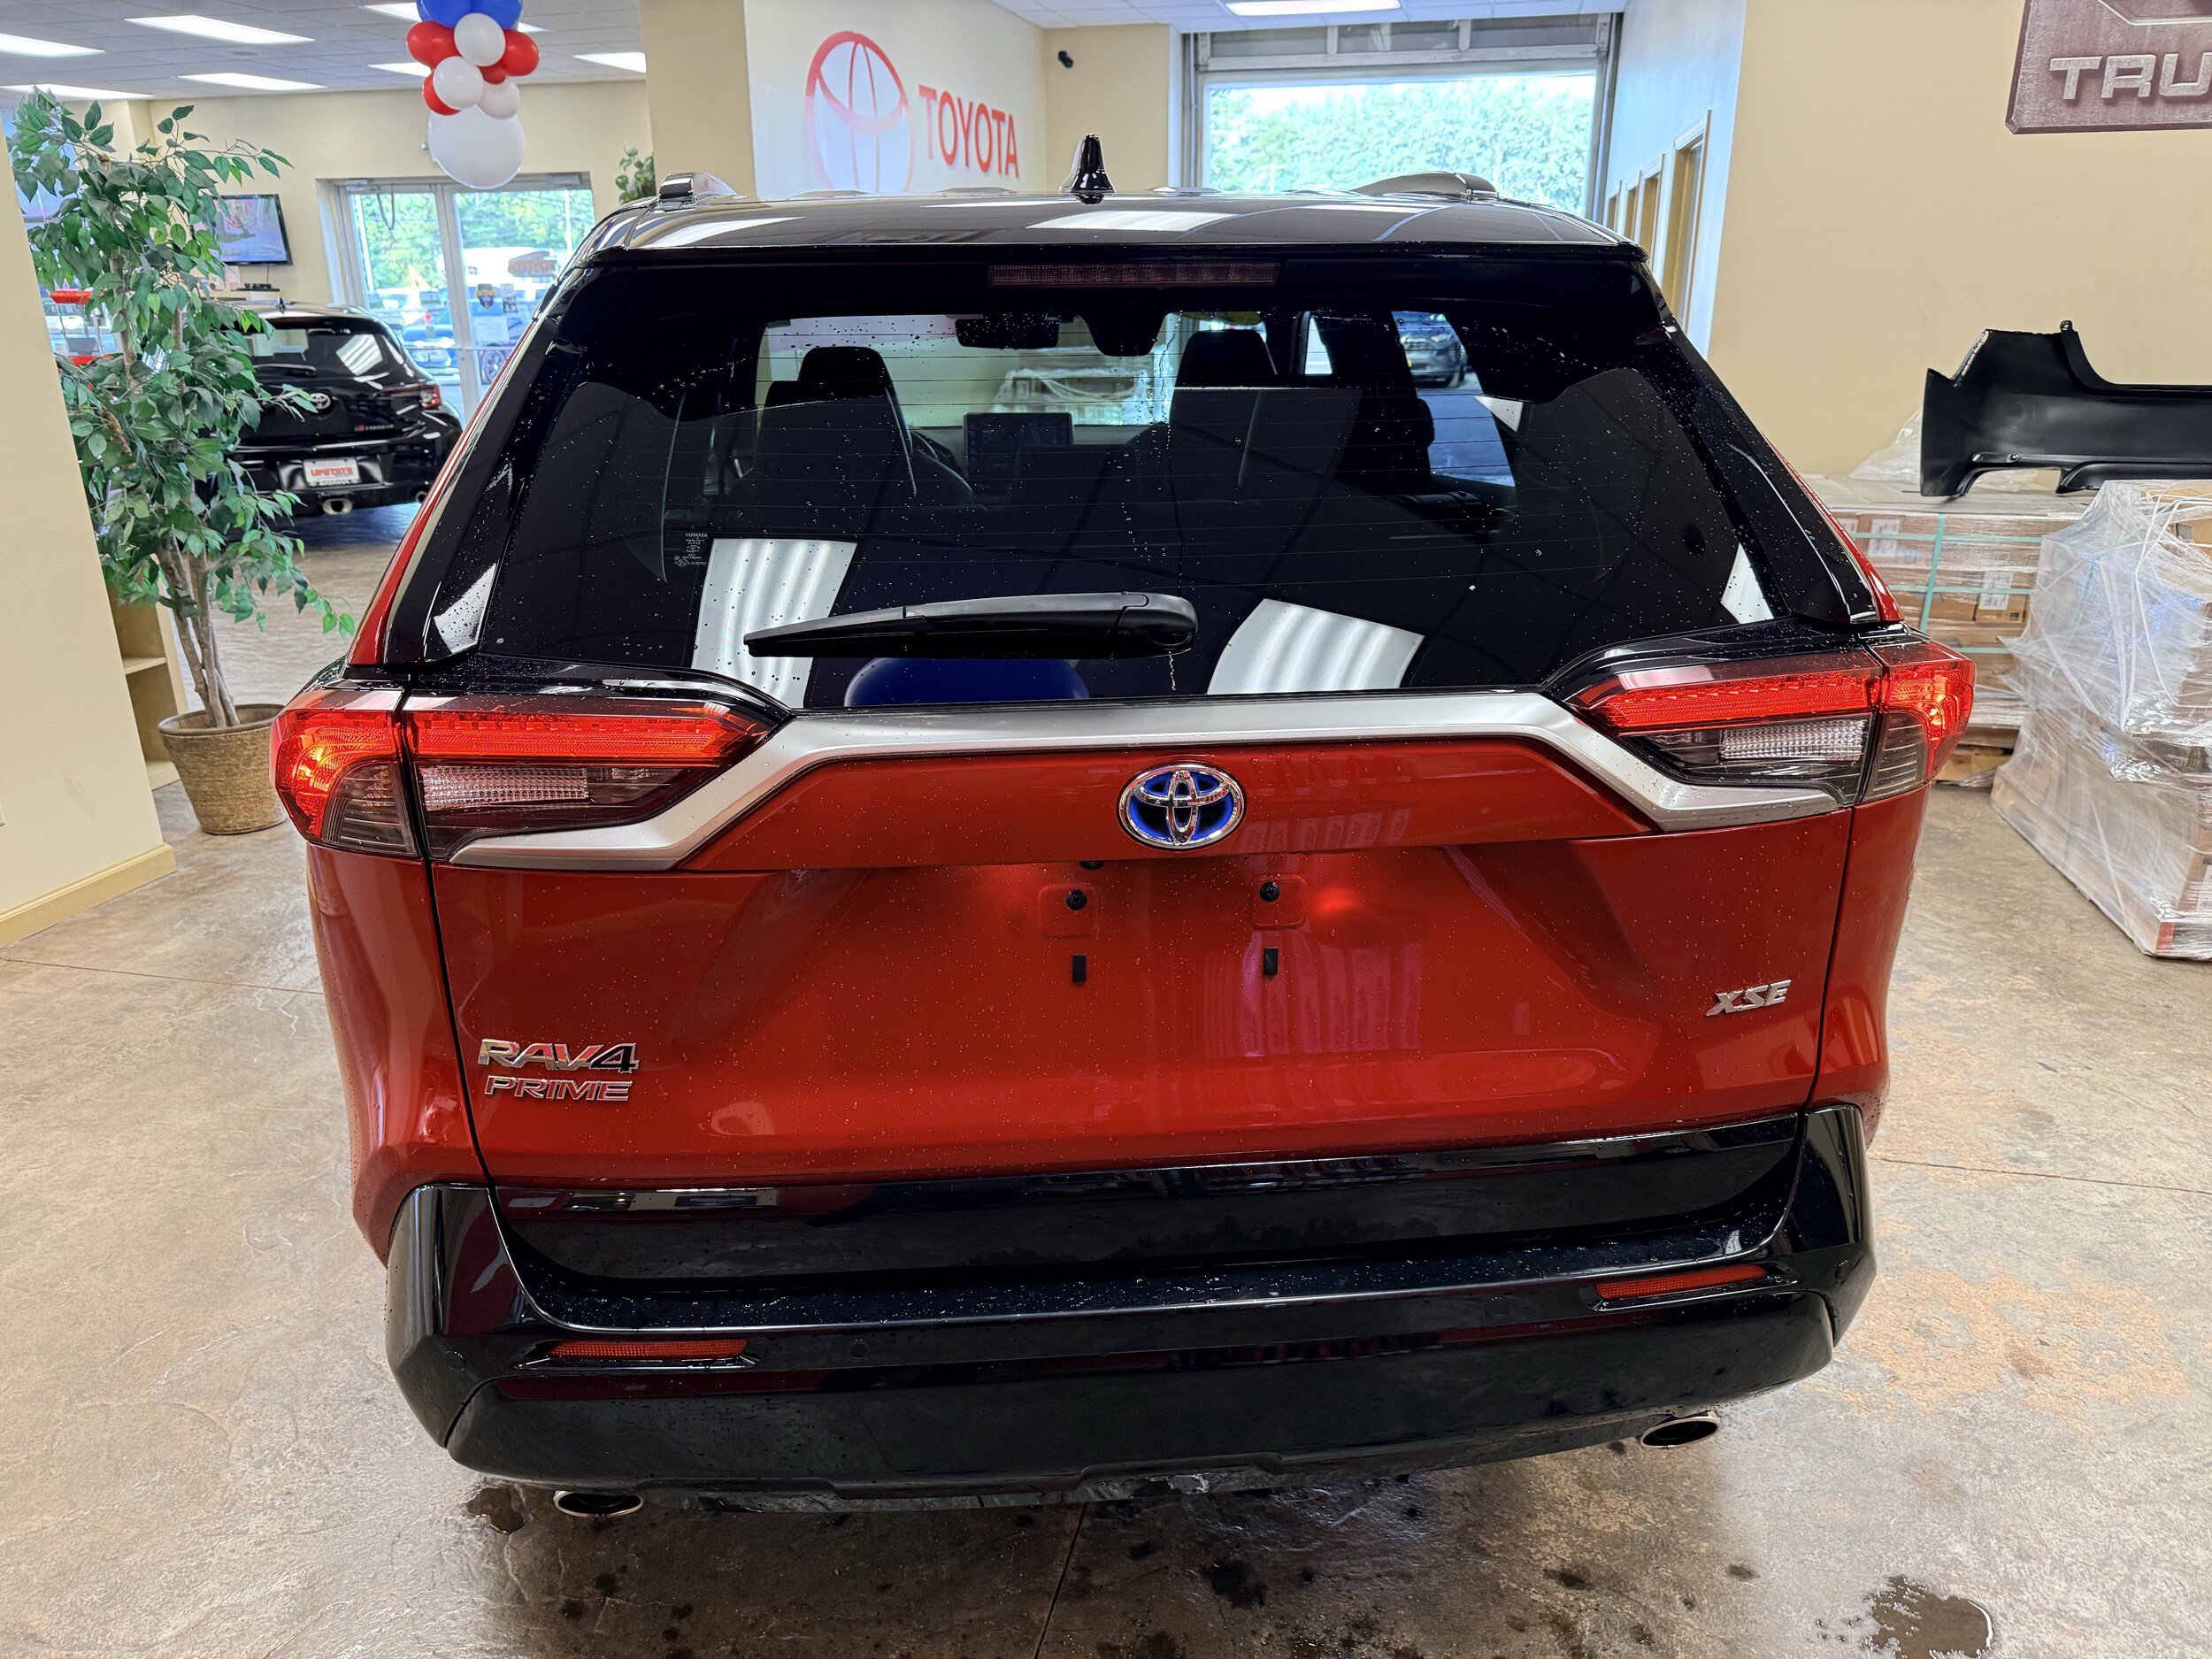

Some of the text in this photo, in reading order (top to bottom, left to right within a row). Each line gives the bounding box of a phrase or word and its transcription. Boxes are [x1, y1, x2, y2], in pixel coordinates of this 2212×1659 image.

[918, 84, 1019, 179] TOYOTA
[1705, 979, 1792, 1017] XSE
[478, 1038, 639, 1073] RAV4
[484, 1075, 633, 1102] PRIME
